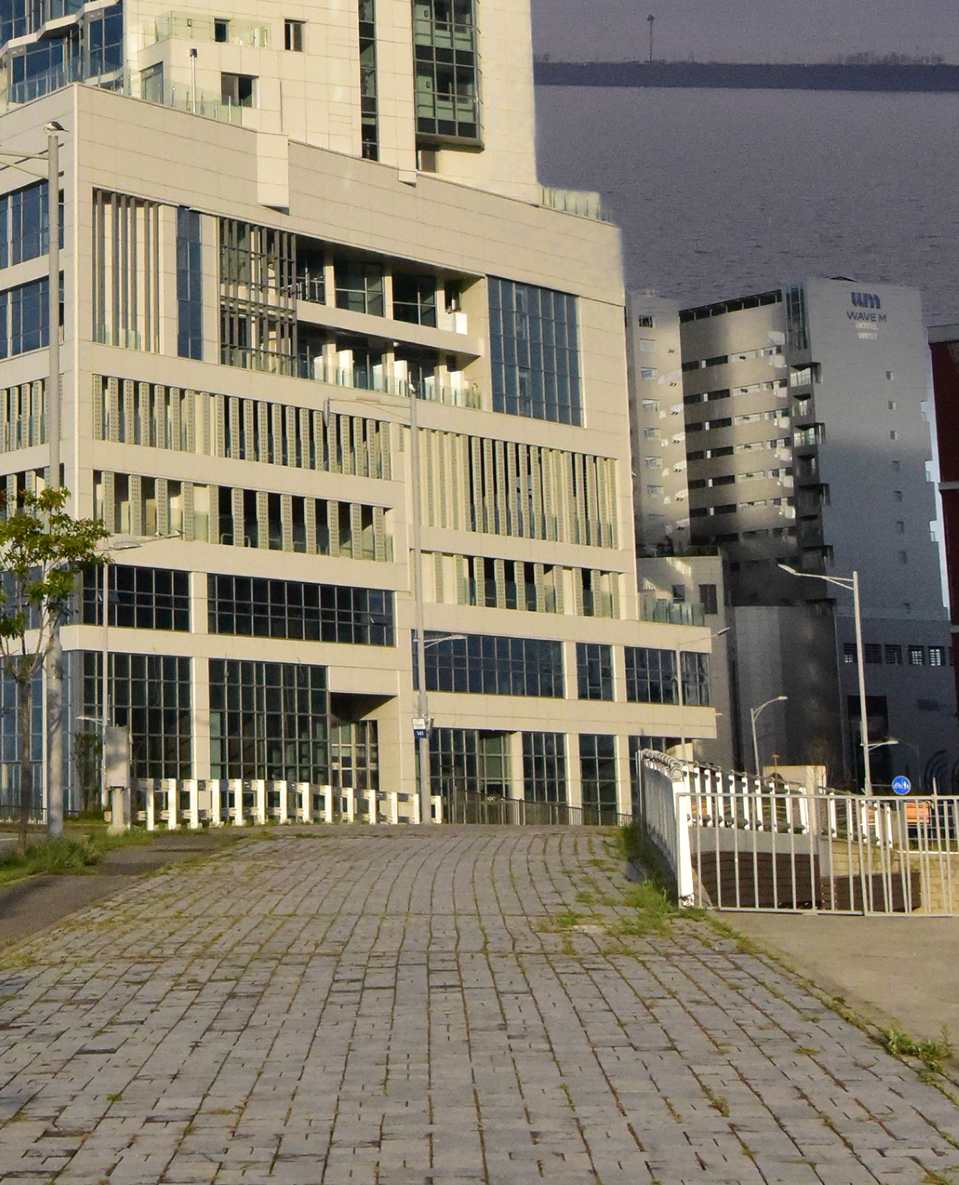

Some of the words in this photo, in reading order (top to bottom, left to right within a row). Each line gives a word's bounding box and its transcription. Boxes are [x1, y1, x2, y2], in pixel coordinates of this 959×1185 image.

[846, 311, 876, 322] WAVE
[878, 313, 887, 323] M
[855, 322, 879, 330] HOTEL
